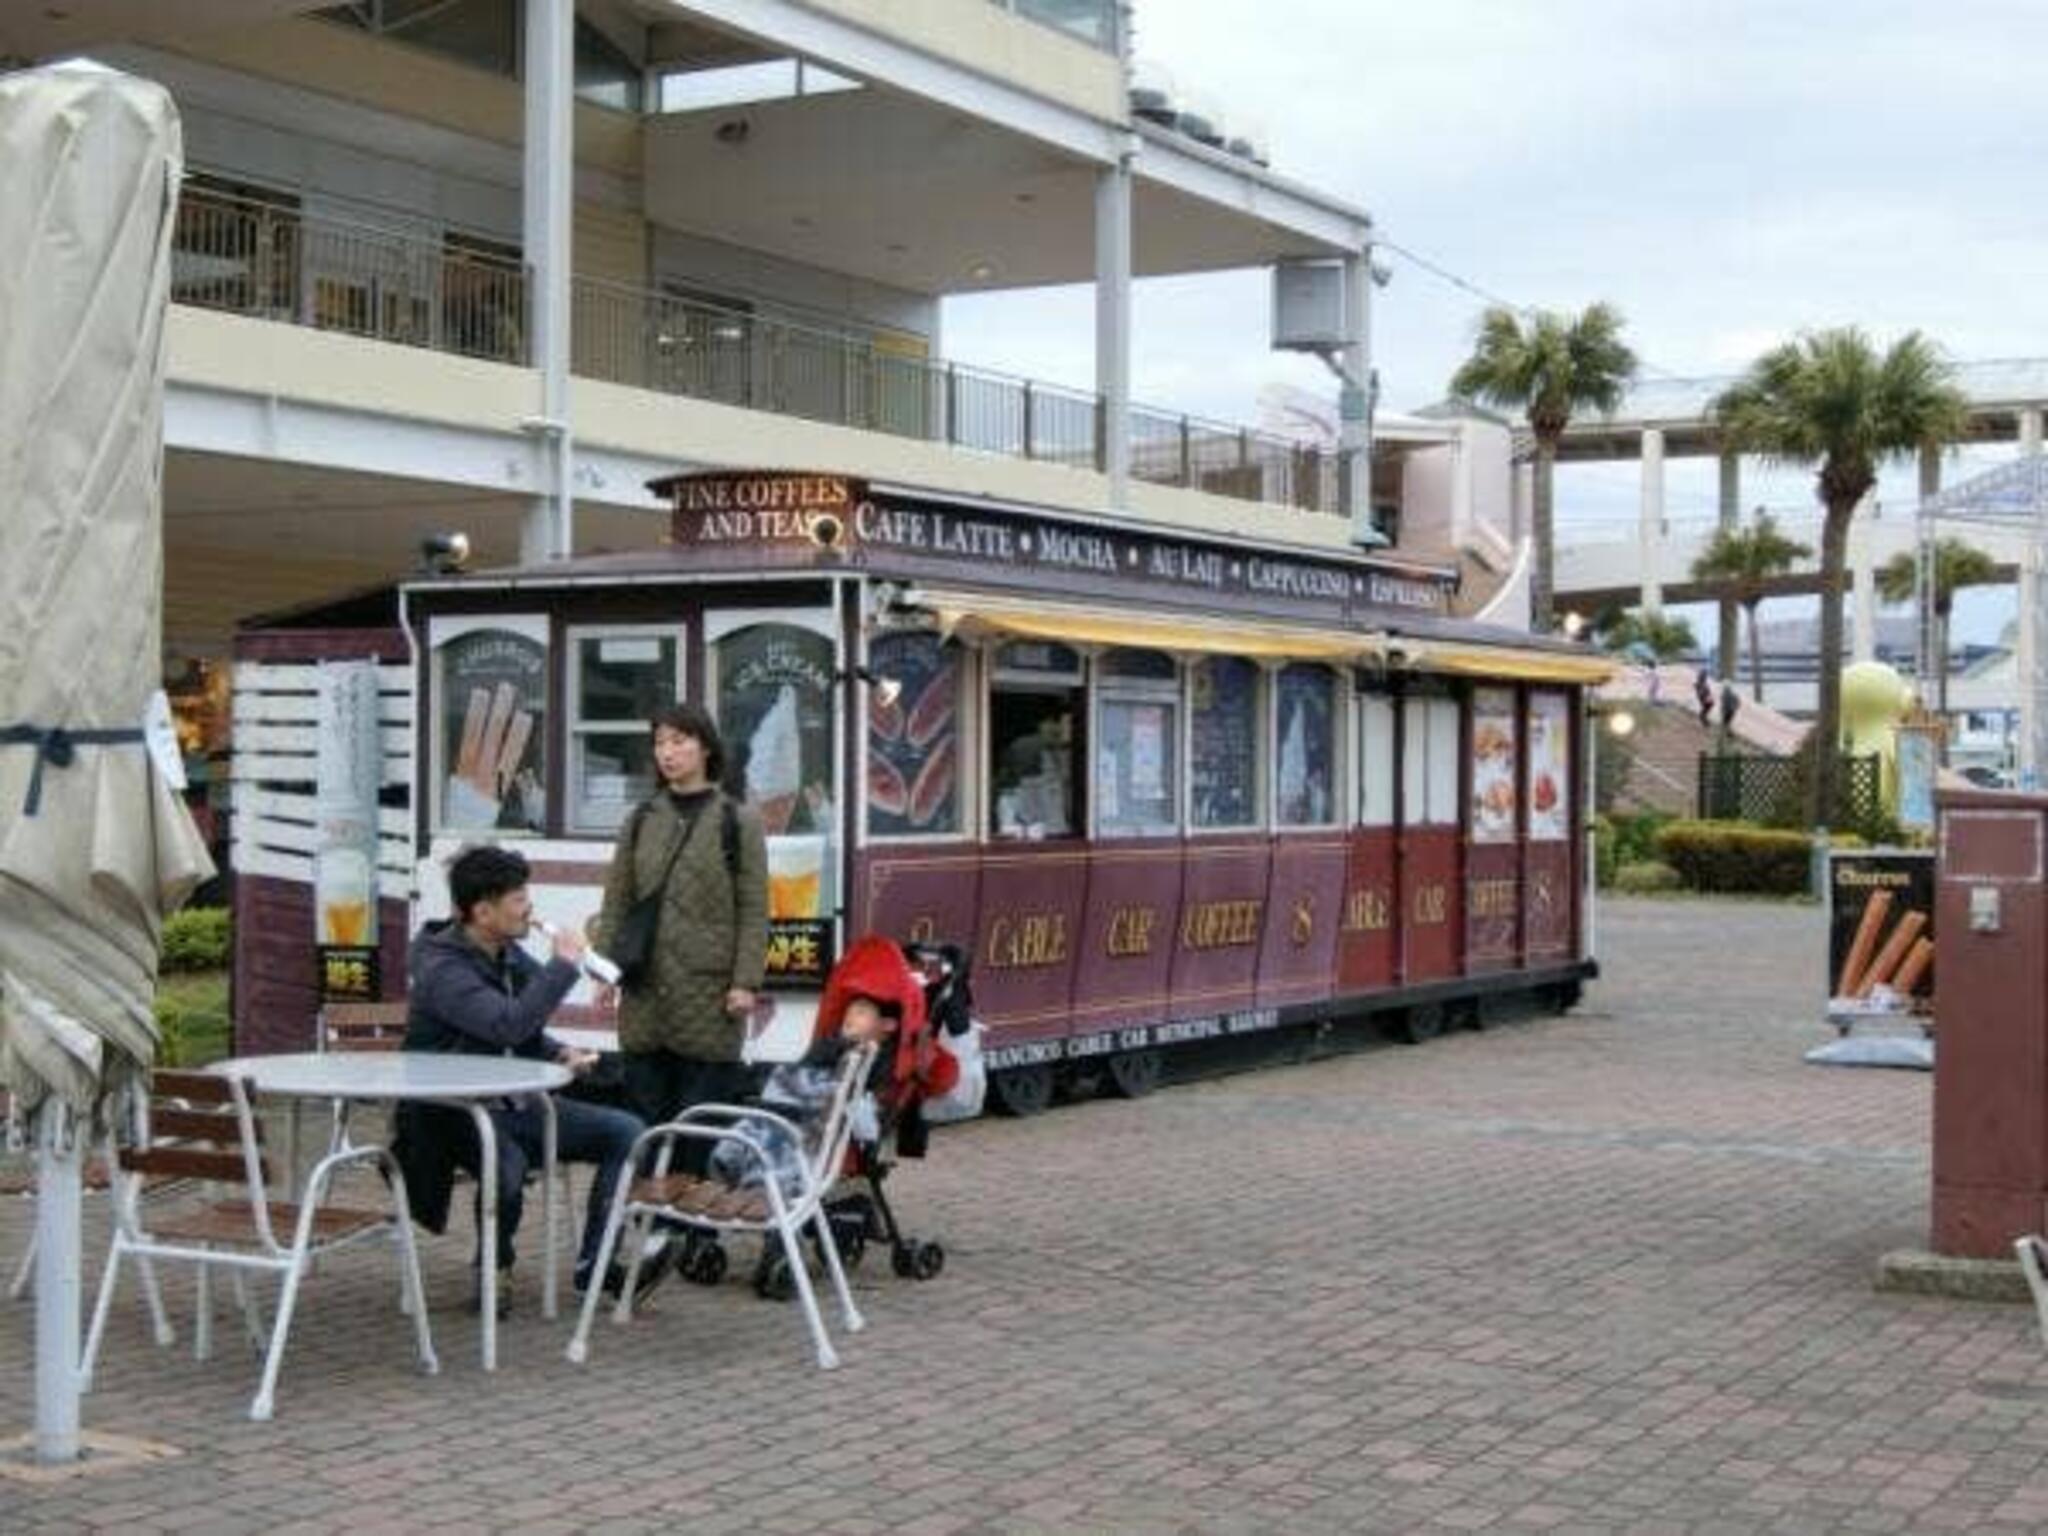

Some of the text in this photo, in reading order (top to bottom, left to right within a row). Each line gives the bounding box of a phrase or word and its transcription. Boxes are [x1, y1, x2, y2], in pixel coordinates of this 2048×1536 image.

[674, 477, 848, 508] FINE COFFEES
[699, 511, 751, 541] AND
[934, 513, 1015, 559] LATTE
[1039, 526, 1118, 571] MOCHA
[988, 915, 1067, 967] CABLE
[1107, 908, 1156, 957] CAR
